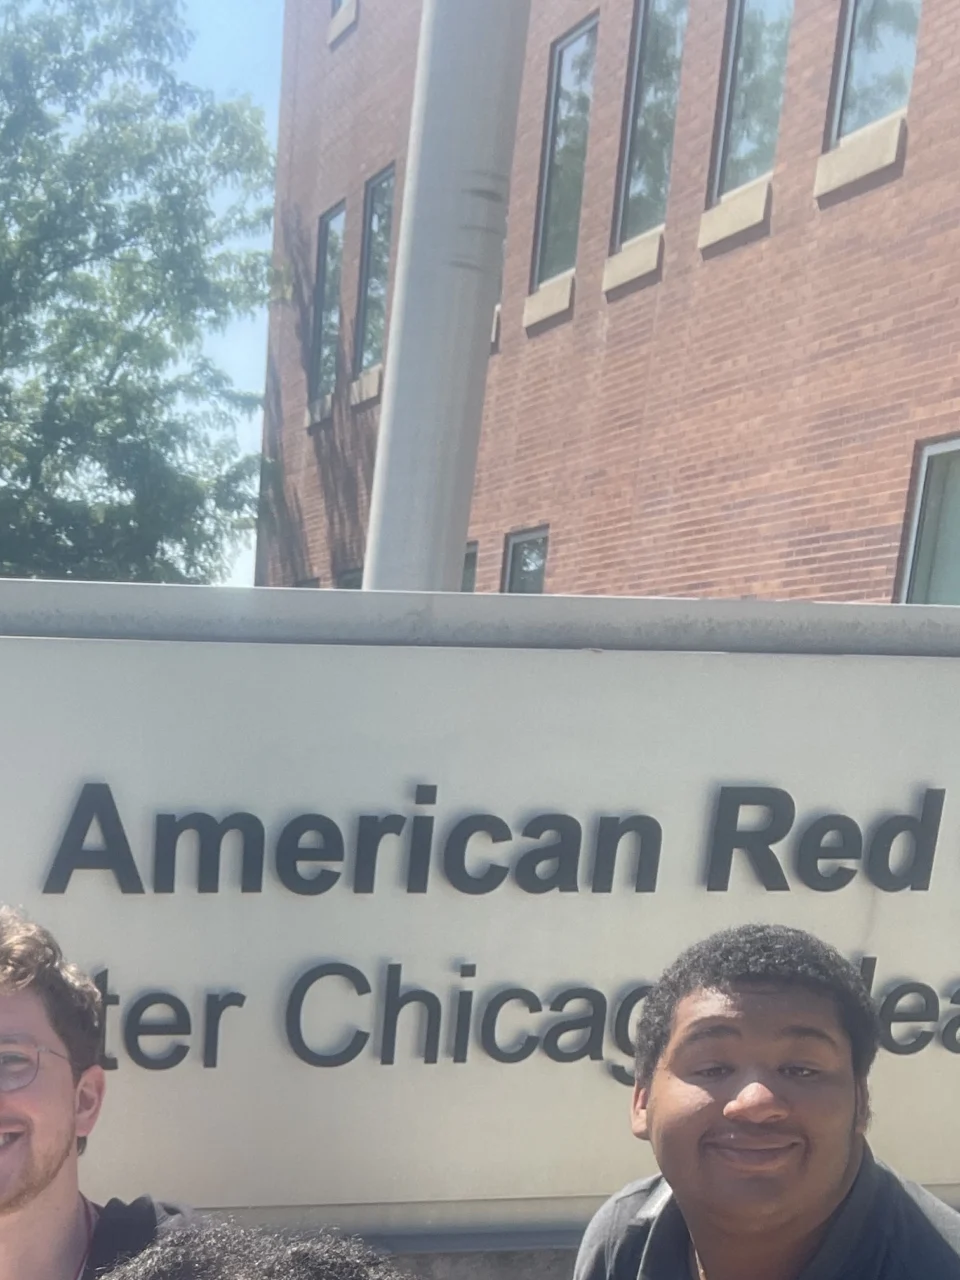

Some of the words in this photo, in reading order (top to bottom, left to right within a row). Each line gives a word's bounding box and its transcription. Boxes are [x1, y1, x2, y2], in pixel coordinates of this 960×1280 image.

[42, 782, 664, 896] American
[706, 784, 945, 893] Red
[284, 956, 653, 1086] Chicag
